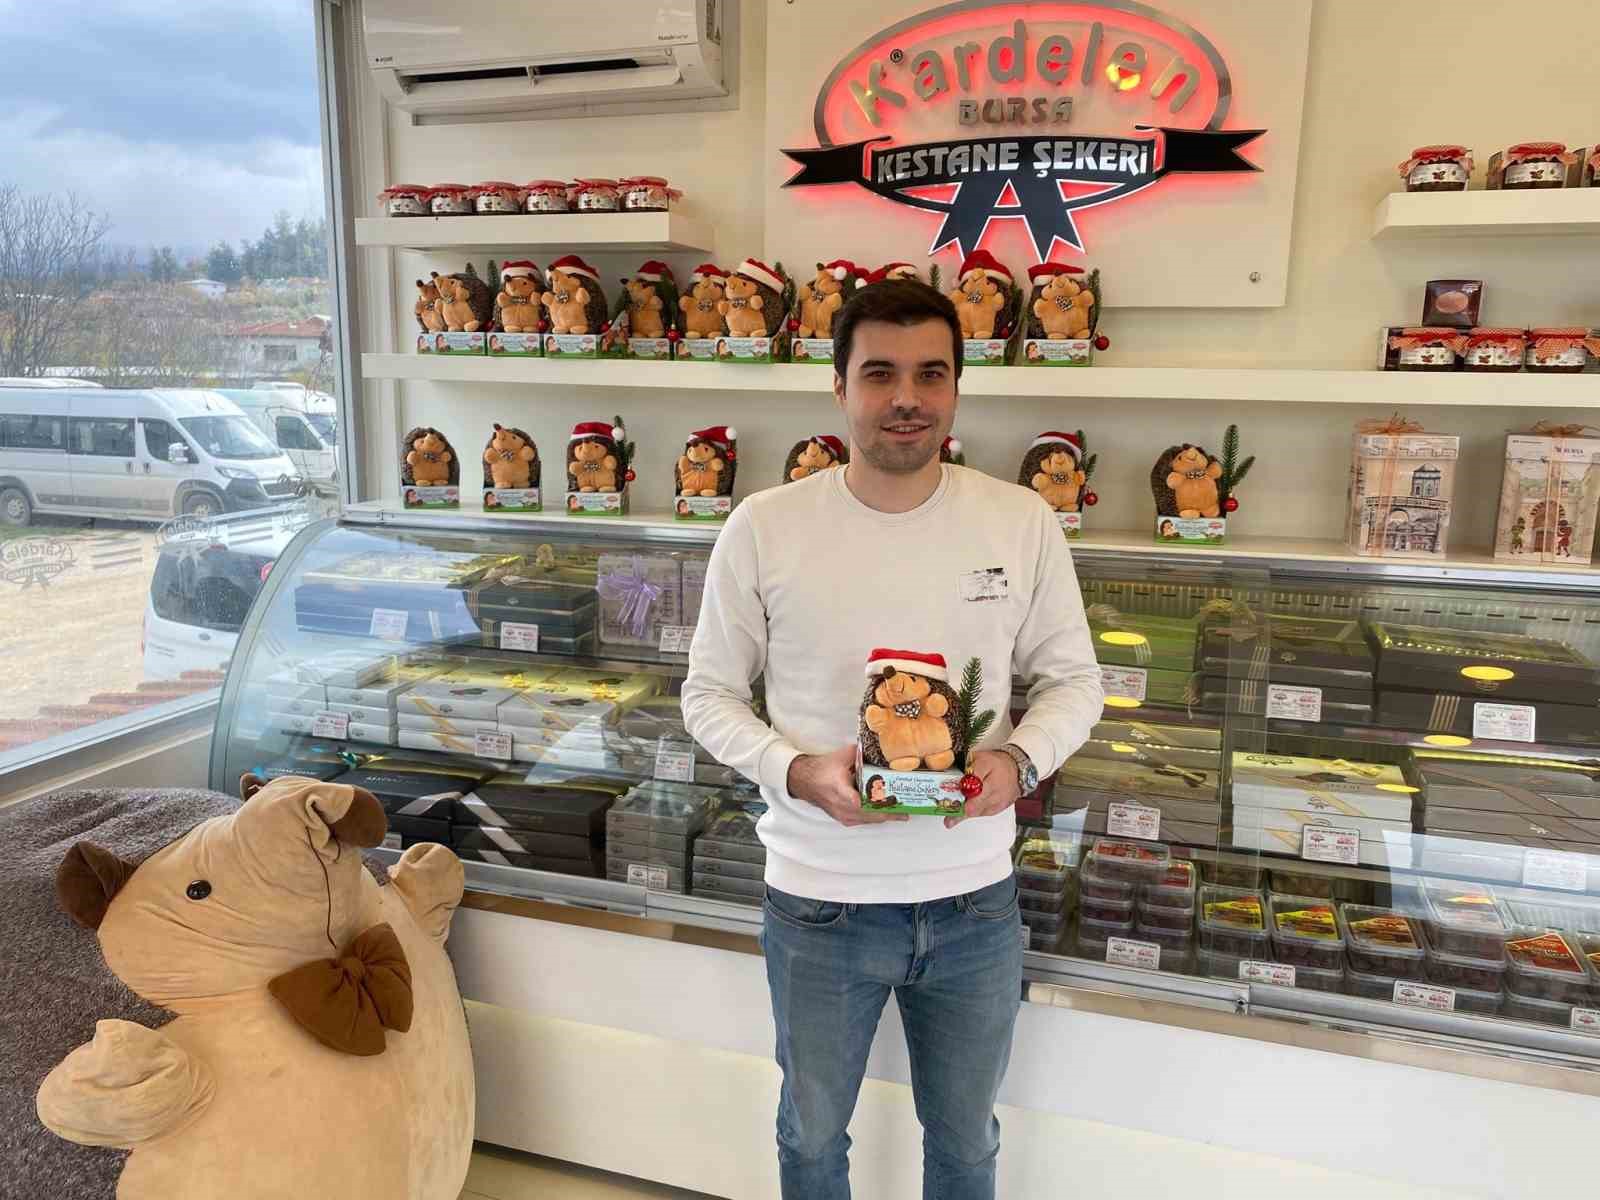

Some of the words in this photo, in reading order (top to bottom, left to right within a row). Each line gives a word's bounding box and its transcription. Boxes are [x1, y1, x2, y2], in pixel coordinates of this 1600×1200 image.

[849, 19, 1199, 127] Kardelen
[959, 97, 1073, 125] BURSA
[878, 143, 1020, 183] KESTANE
